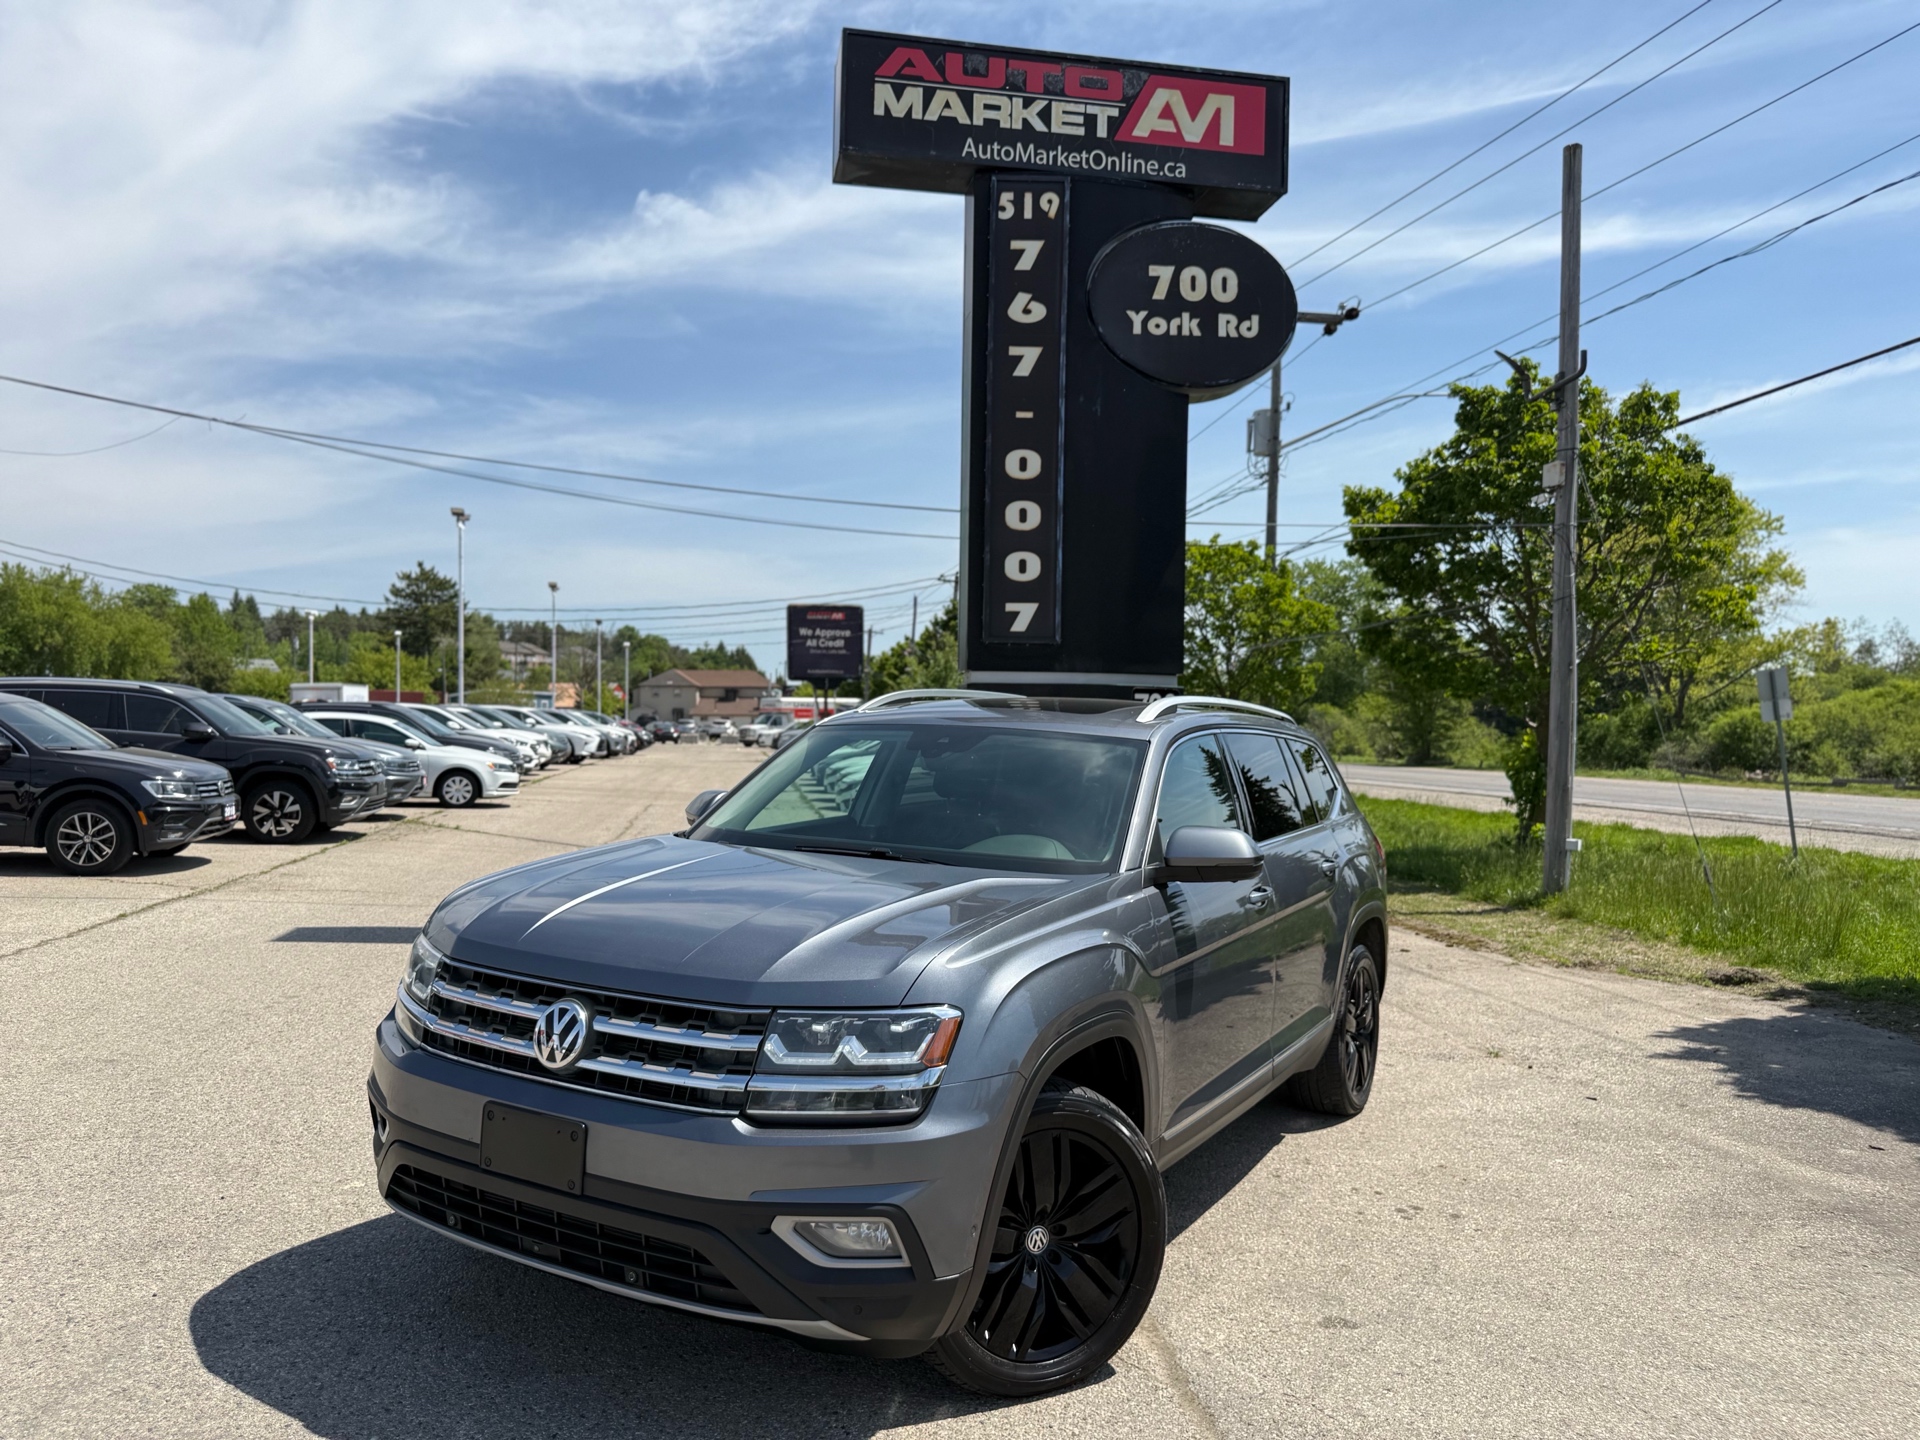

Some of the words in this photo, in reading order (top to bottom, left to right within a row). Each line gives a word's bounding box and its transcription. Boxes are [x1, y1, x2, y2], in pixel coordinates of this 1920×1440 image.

[874, 46, 1123, 101] AUTO
[873, 82, 1119, 138] MARKET
[1131, 87, 1235, 147] AM
[962, 136, 1187, 179] AutoMarketOnline.ca
[997, 191, 1060, 220] 519
[1148, 264, 1239, 303] 700
[1126, 310, 1202, 337] York
[1217, 312, 1260, 338] Rd
[798, 627, 813, 637] We
[815, 627, 851, 638] Approve
[806, 638, 817, 647] All
[818, 638, 845, 647] Credit
